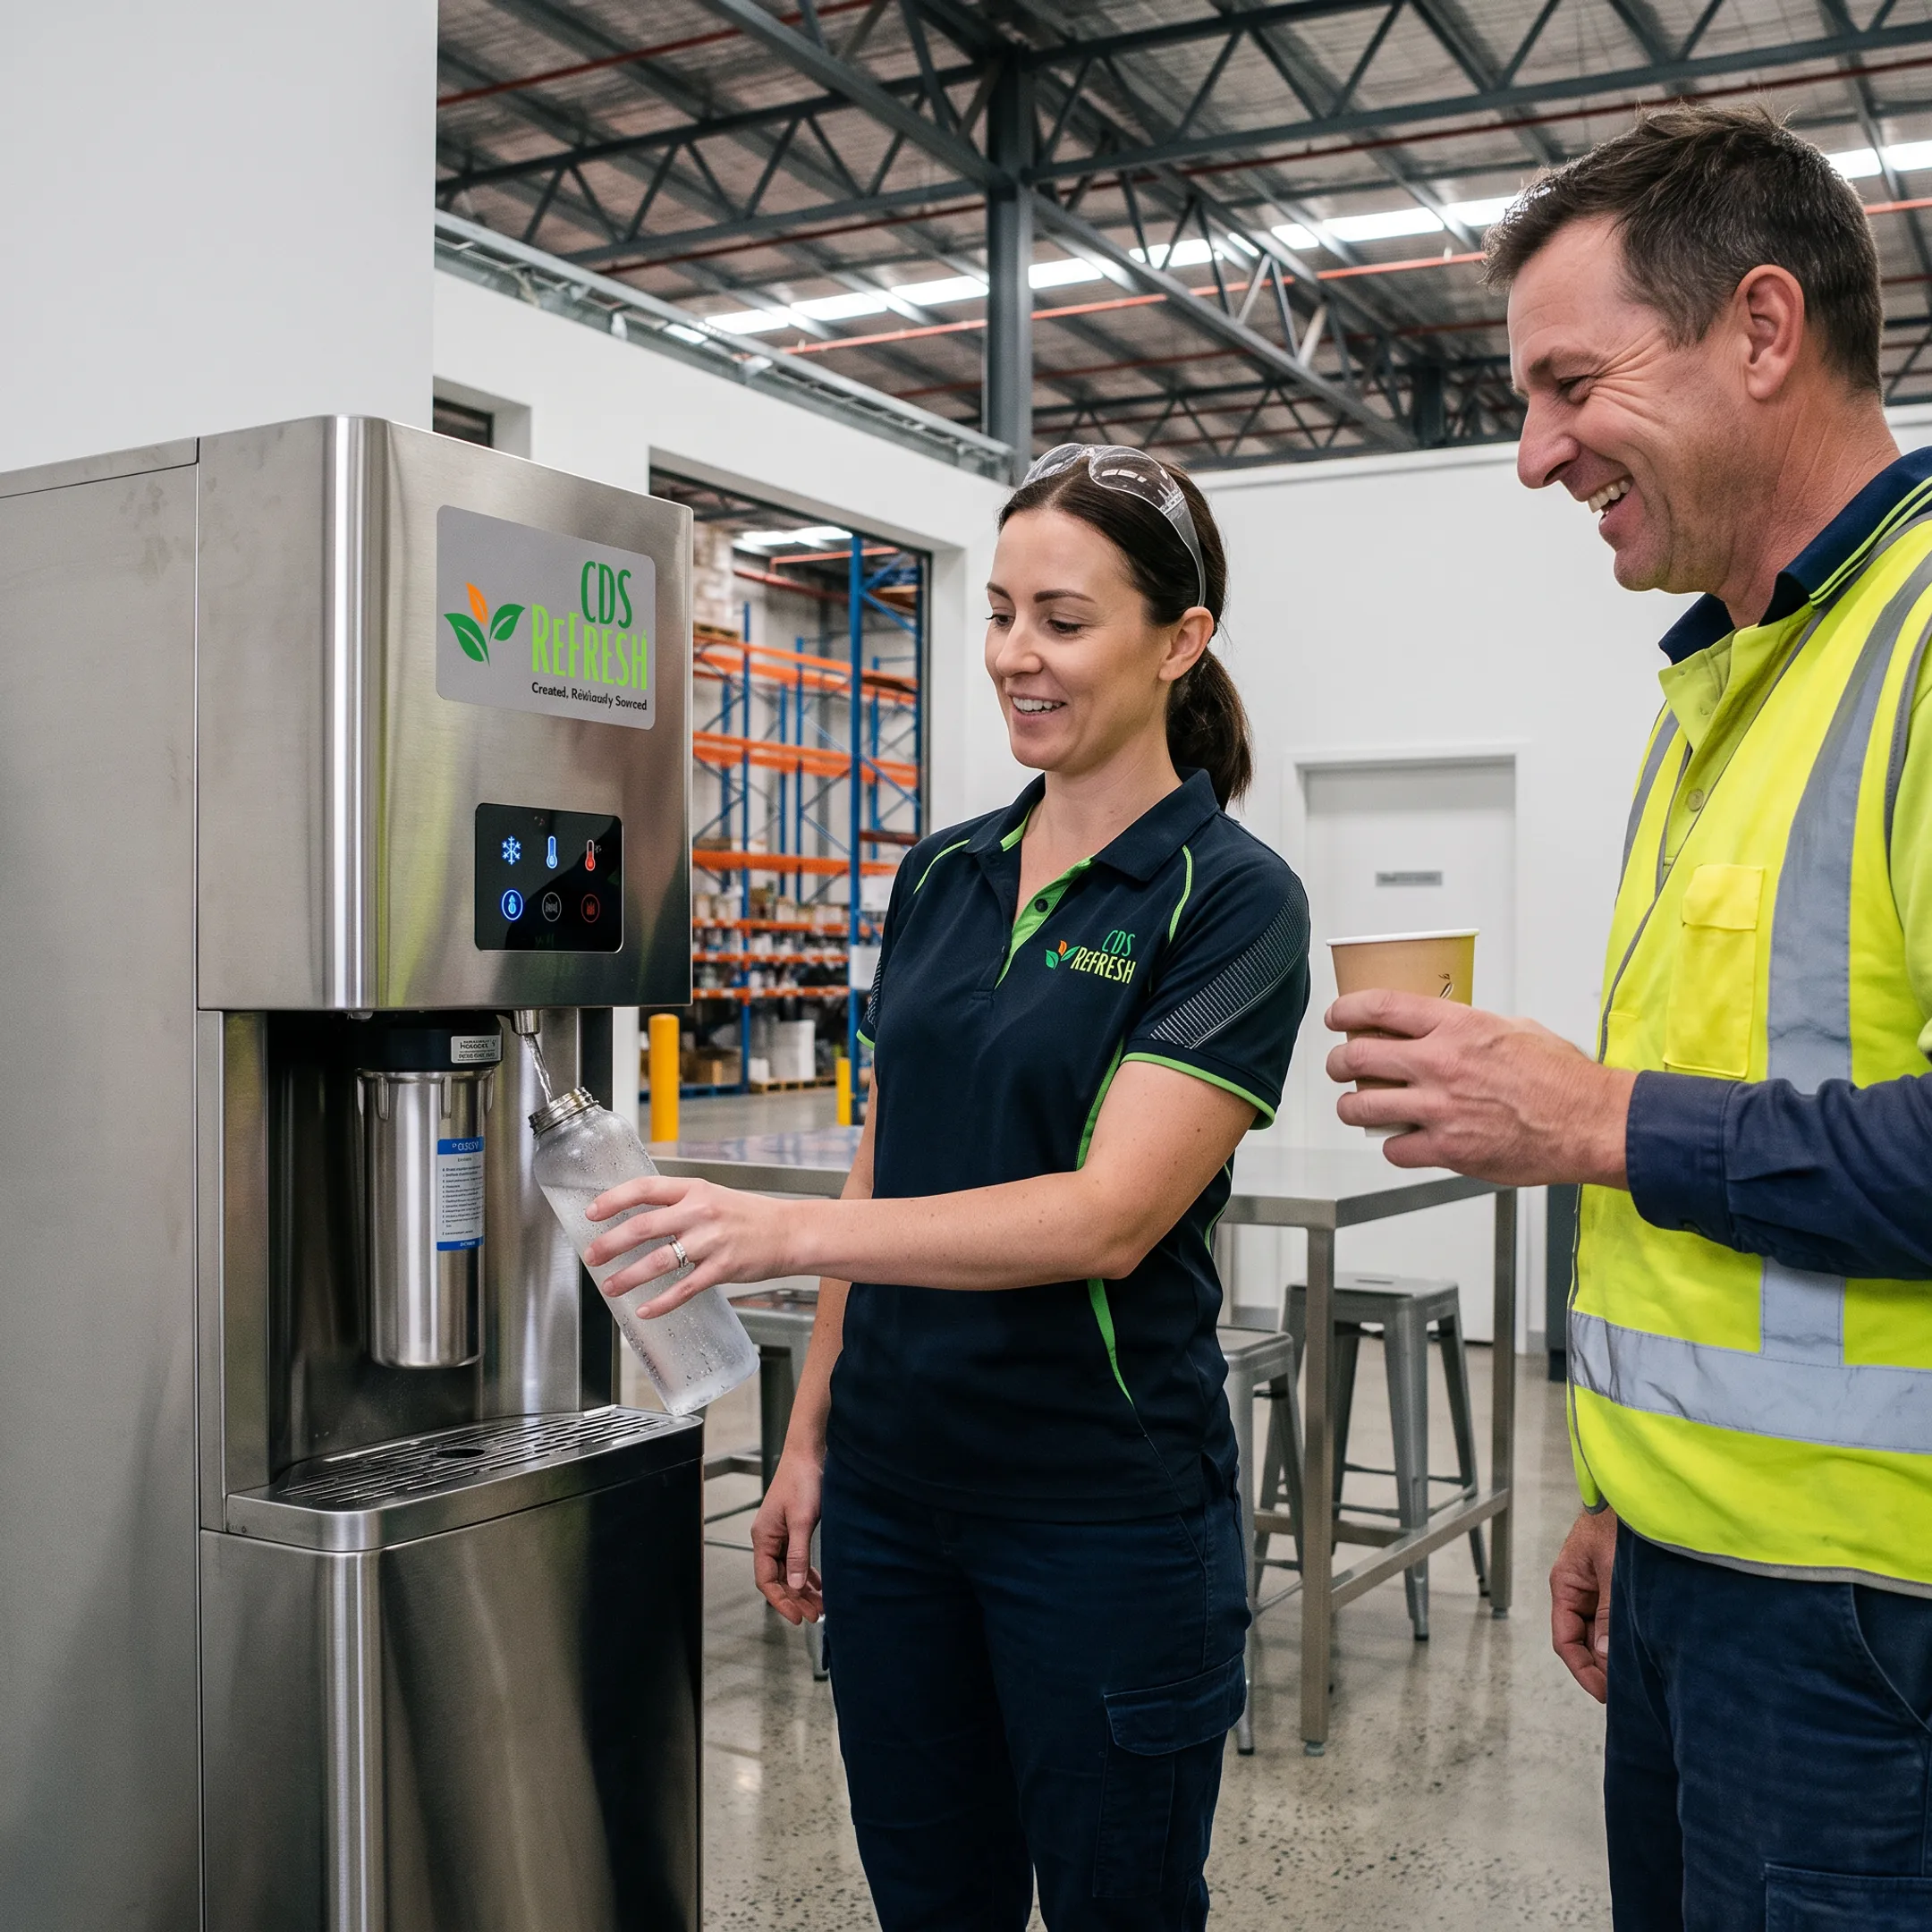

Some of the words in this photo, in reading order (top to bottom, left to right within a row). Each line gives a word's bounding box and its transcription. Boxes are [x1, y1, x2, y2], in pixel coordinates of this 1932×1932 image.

[580, 560, 632, 629] CDS
[531, 603, 648, 691] REFRESH
[531, 682, 569, 699] Created,
[1101, 929, 1136, 957] CDS
[1070, 946, 1137, 984] REFRESH
